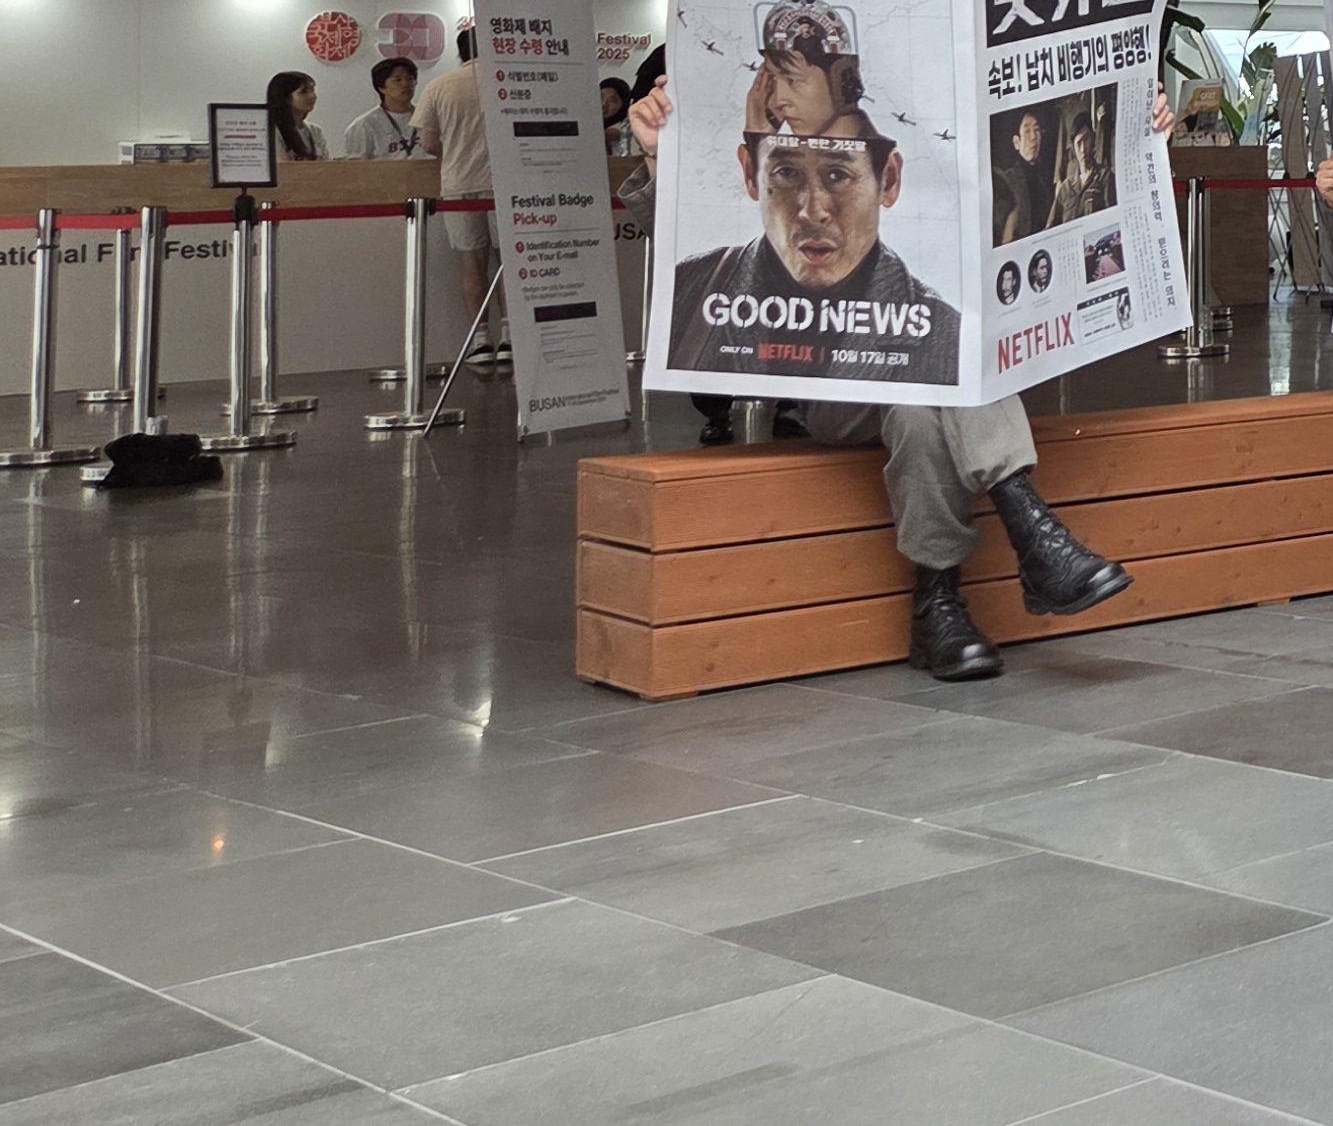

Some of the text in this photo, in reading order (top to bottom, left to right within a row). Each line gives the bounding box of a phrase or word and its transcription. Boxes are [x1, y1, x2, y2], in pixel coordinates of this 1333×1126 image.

[490, 17, 553, 36] 영화제 배지
[492, 37, 570, 57] 현장 수령 안내
[597, 33, 652, 51] Festival
[597, 47, 631, 61] 2025
[987, 24, 1152, 100] 속보! 납치 비행기의 평양행!
[511, 193, 595, 209] Festival Badge
[512, 212, 558, 226] Pick-up
[701, 292, 932, 338] GOOD NEWS
[757, 342, 814, 363] NETFLIX
[997, 311, 1076, 375] NETFLIX
[528, 395, 567, 413] BUSAN
